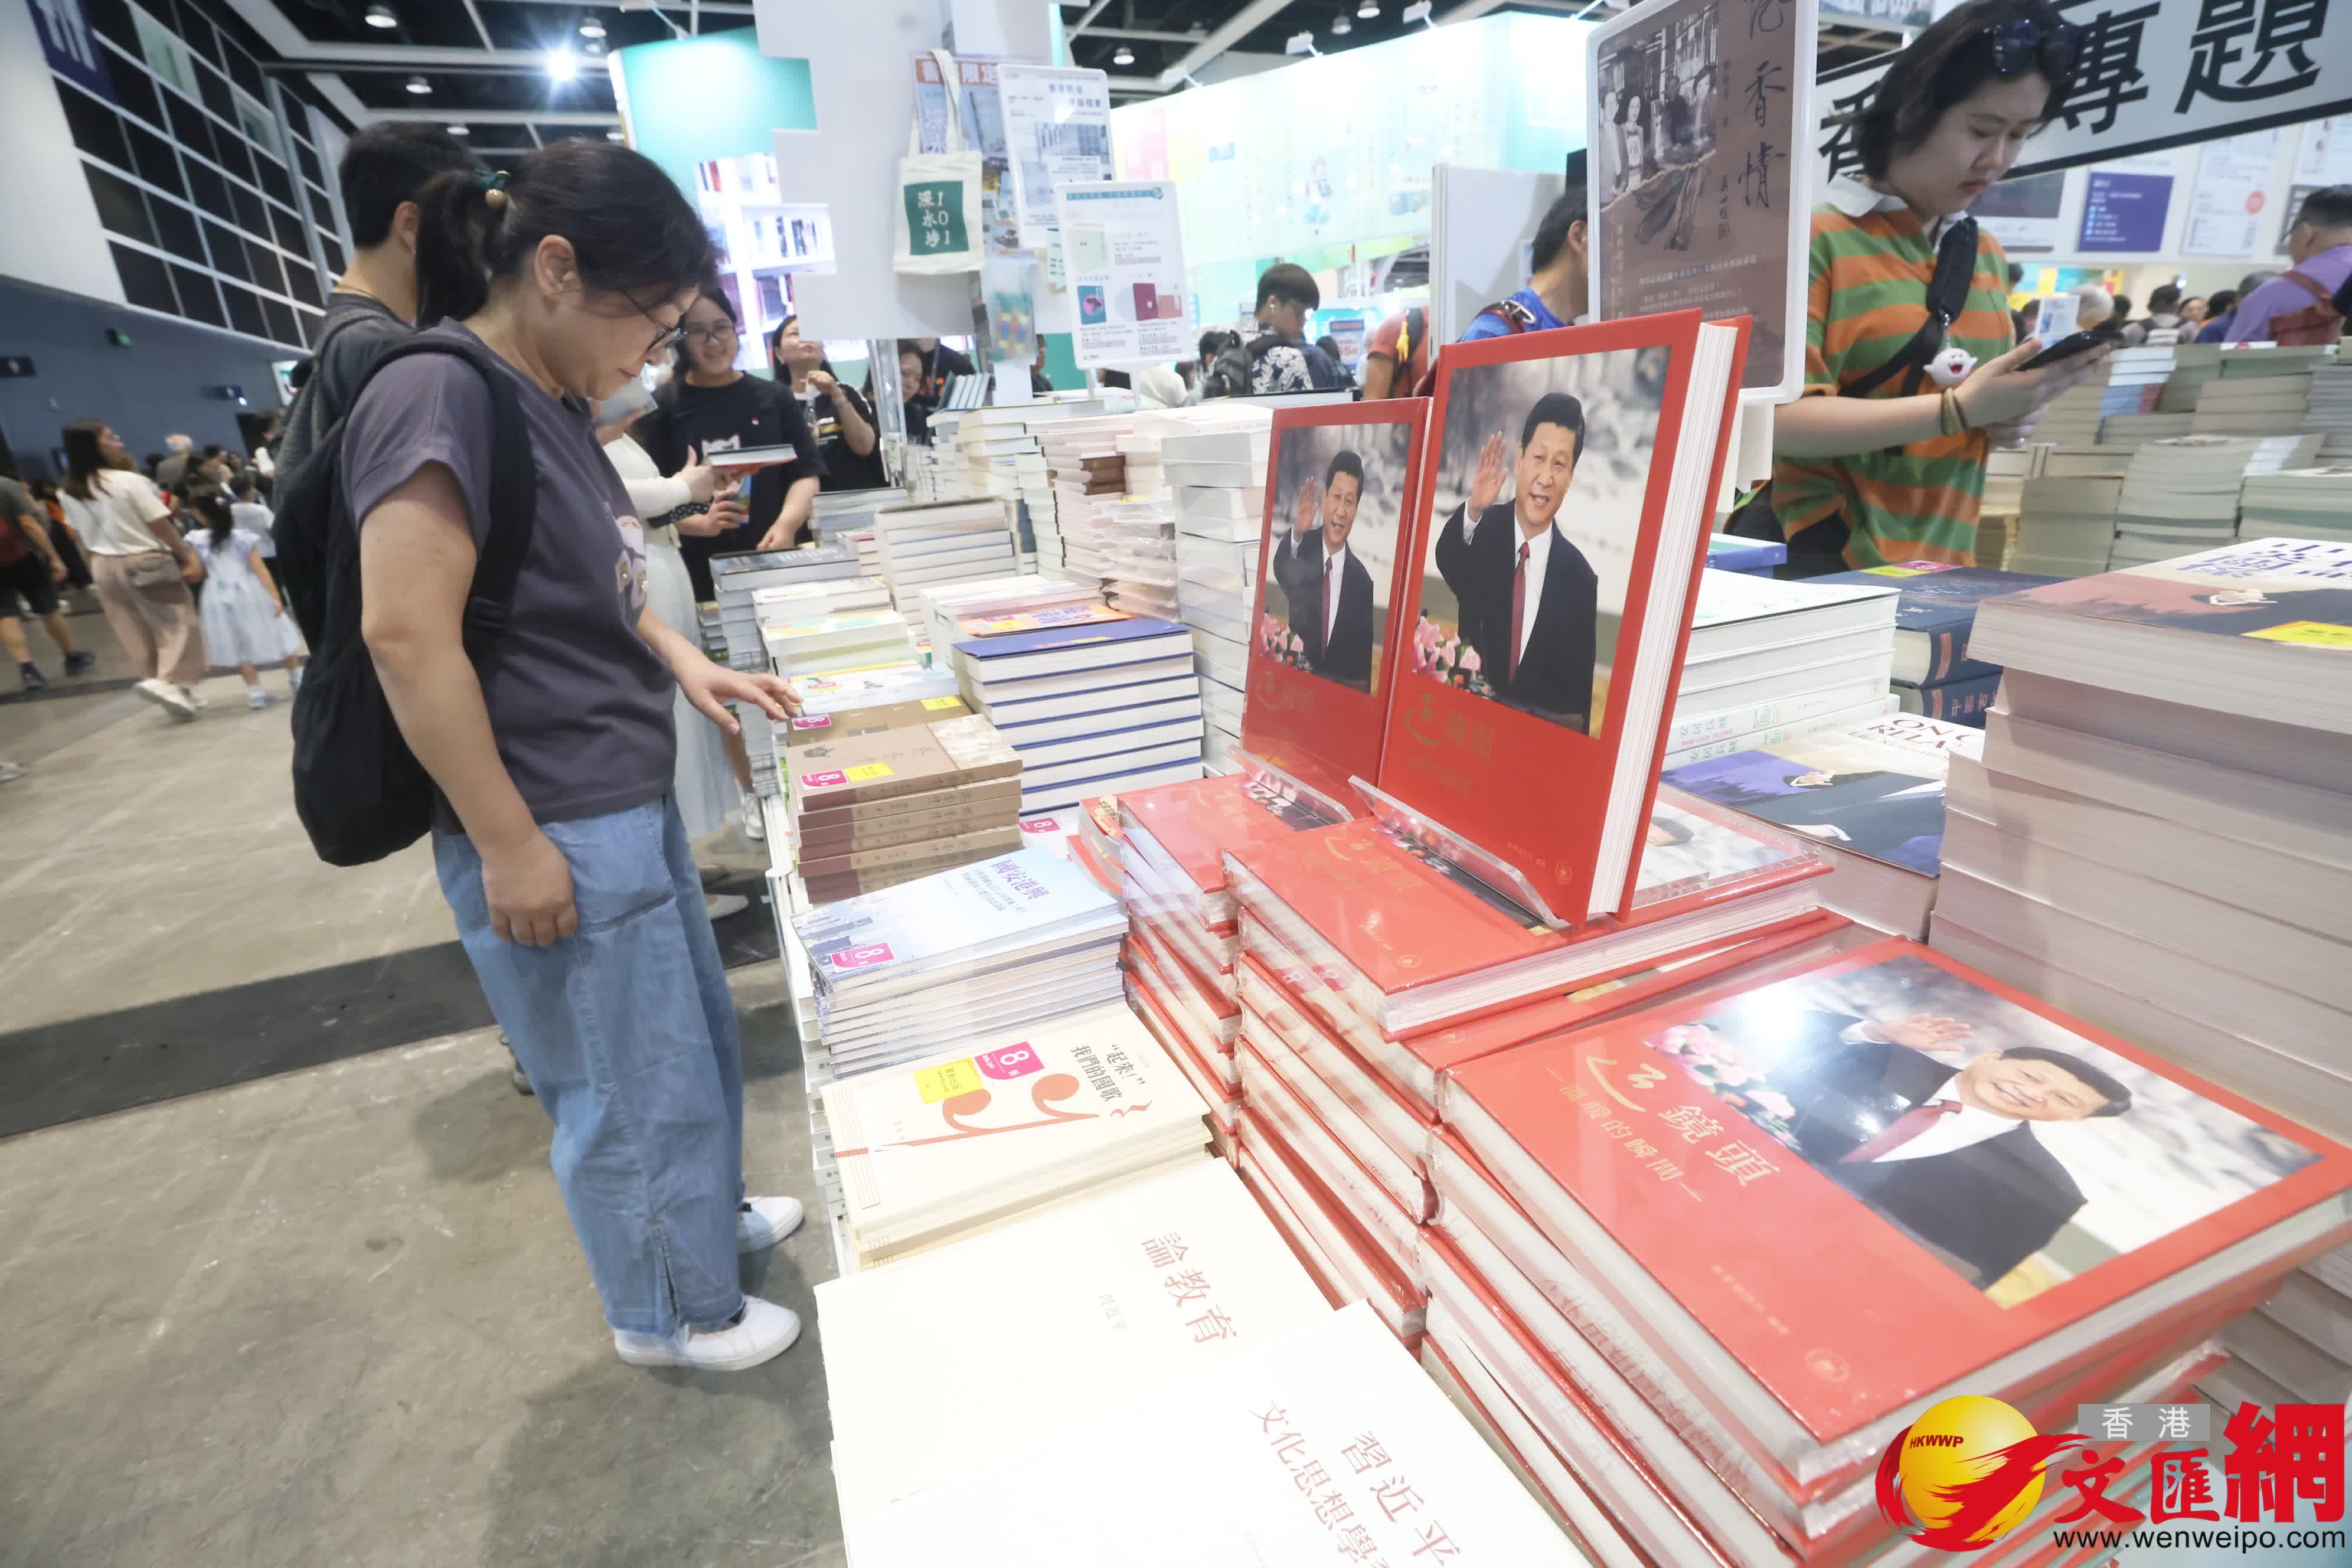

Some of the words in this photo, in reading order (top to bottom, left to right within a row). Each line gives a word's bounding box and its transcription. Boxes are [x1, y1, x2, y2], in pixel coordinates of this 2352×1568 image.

[1000, 1050, 1030, 1066] 8
[1071, 1044, 1122, 1102] 我們的國歌
[1141, 1231, 1238, 1343] 論教育
[1341, 1430, 1461, 1567] 習近平
